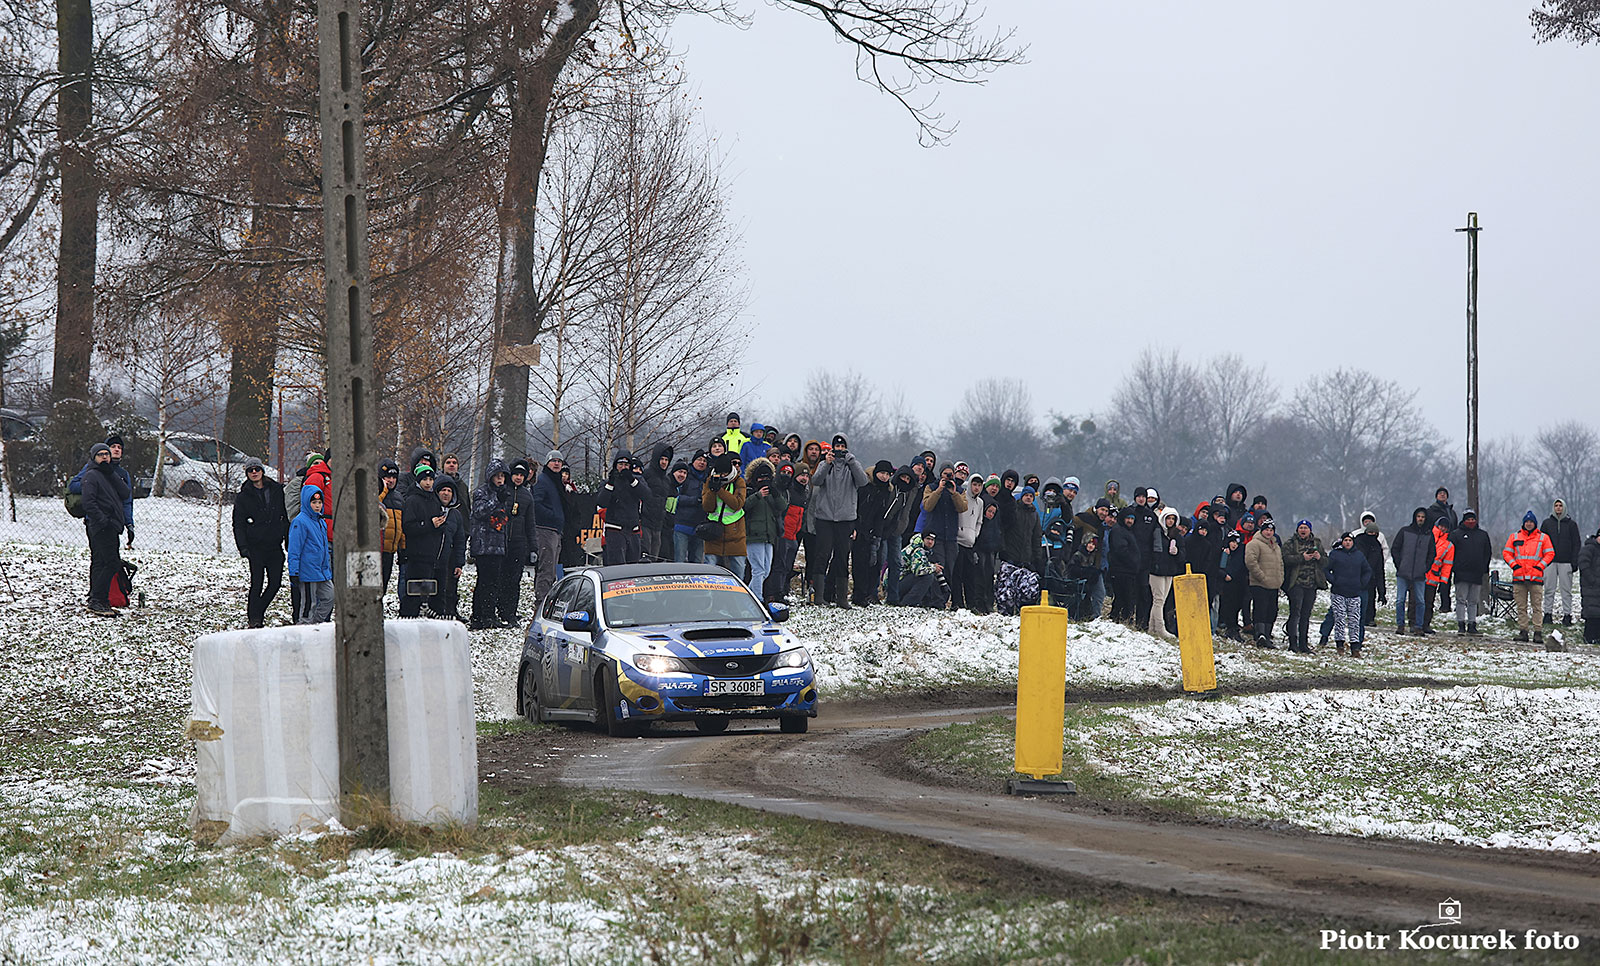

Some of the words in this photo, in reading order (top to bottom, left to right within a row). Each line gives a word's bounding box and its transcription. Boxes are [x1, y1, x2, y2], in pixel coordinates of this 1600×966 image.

[615, 586, 653, 595] CENTRUM
[710, 681, 727, 693] SR
[730, 681, 763, 692] 3608F
